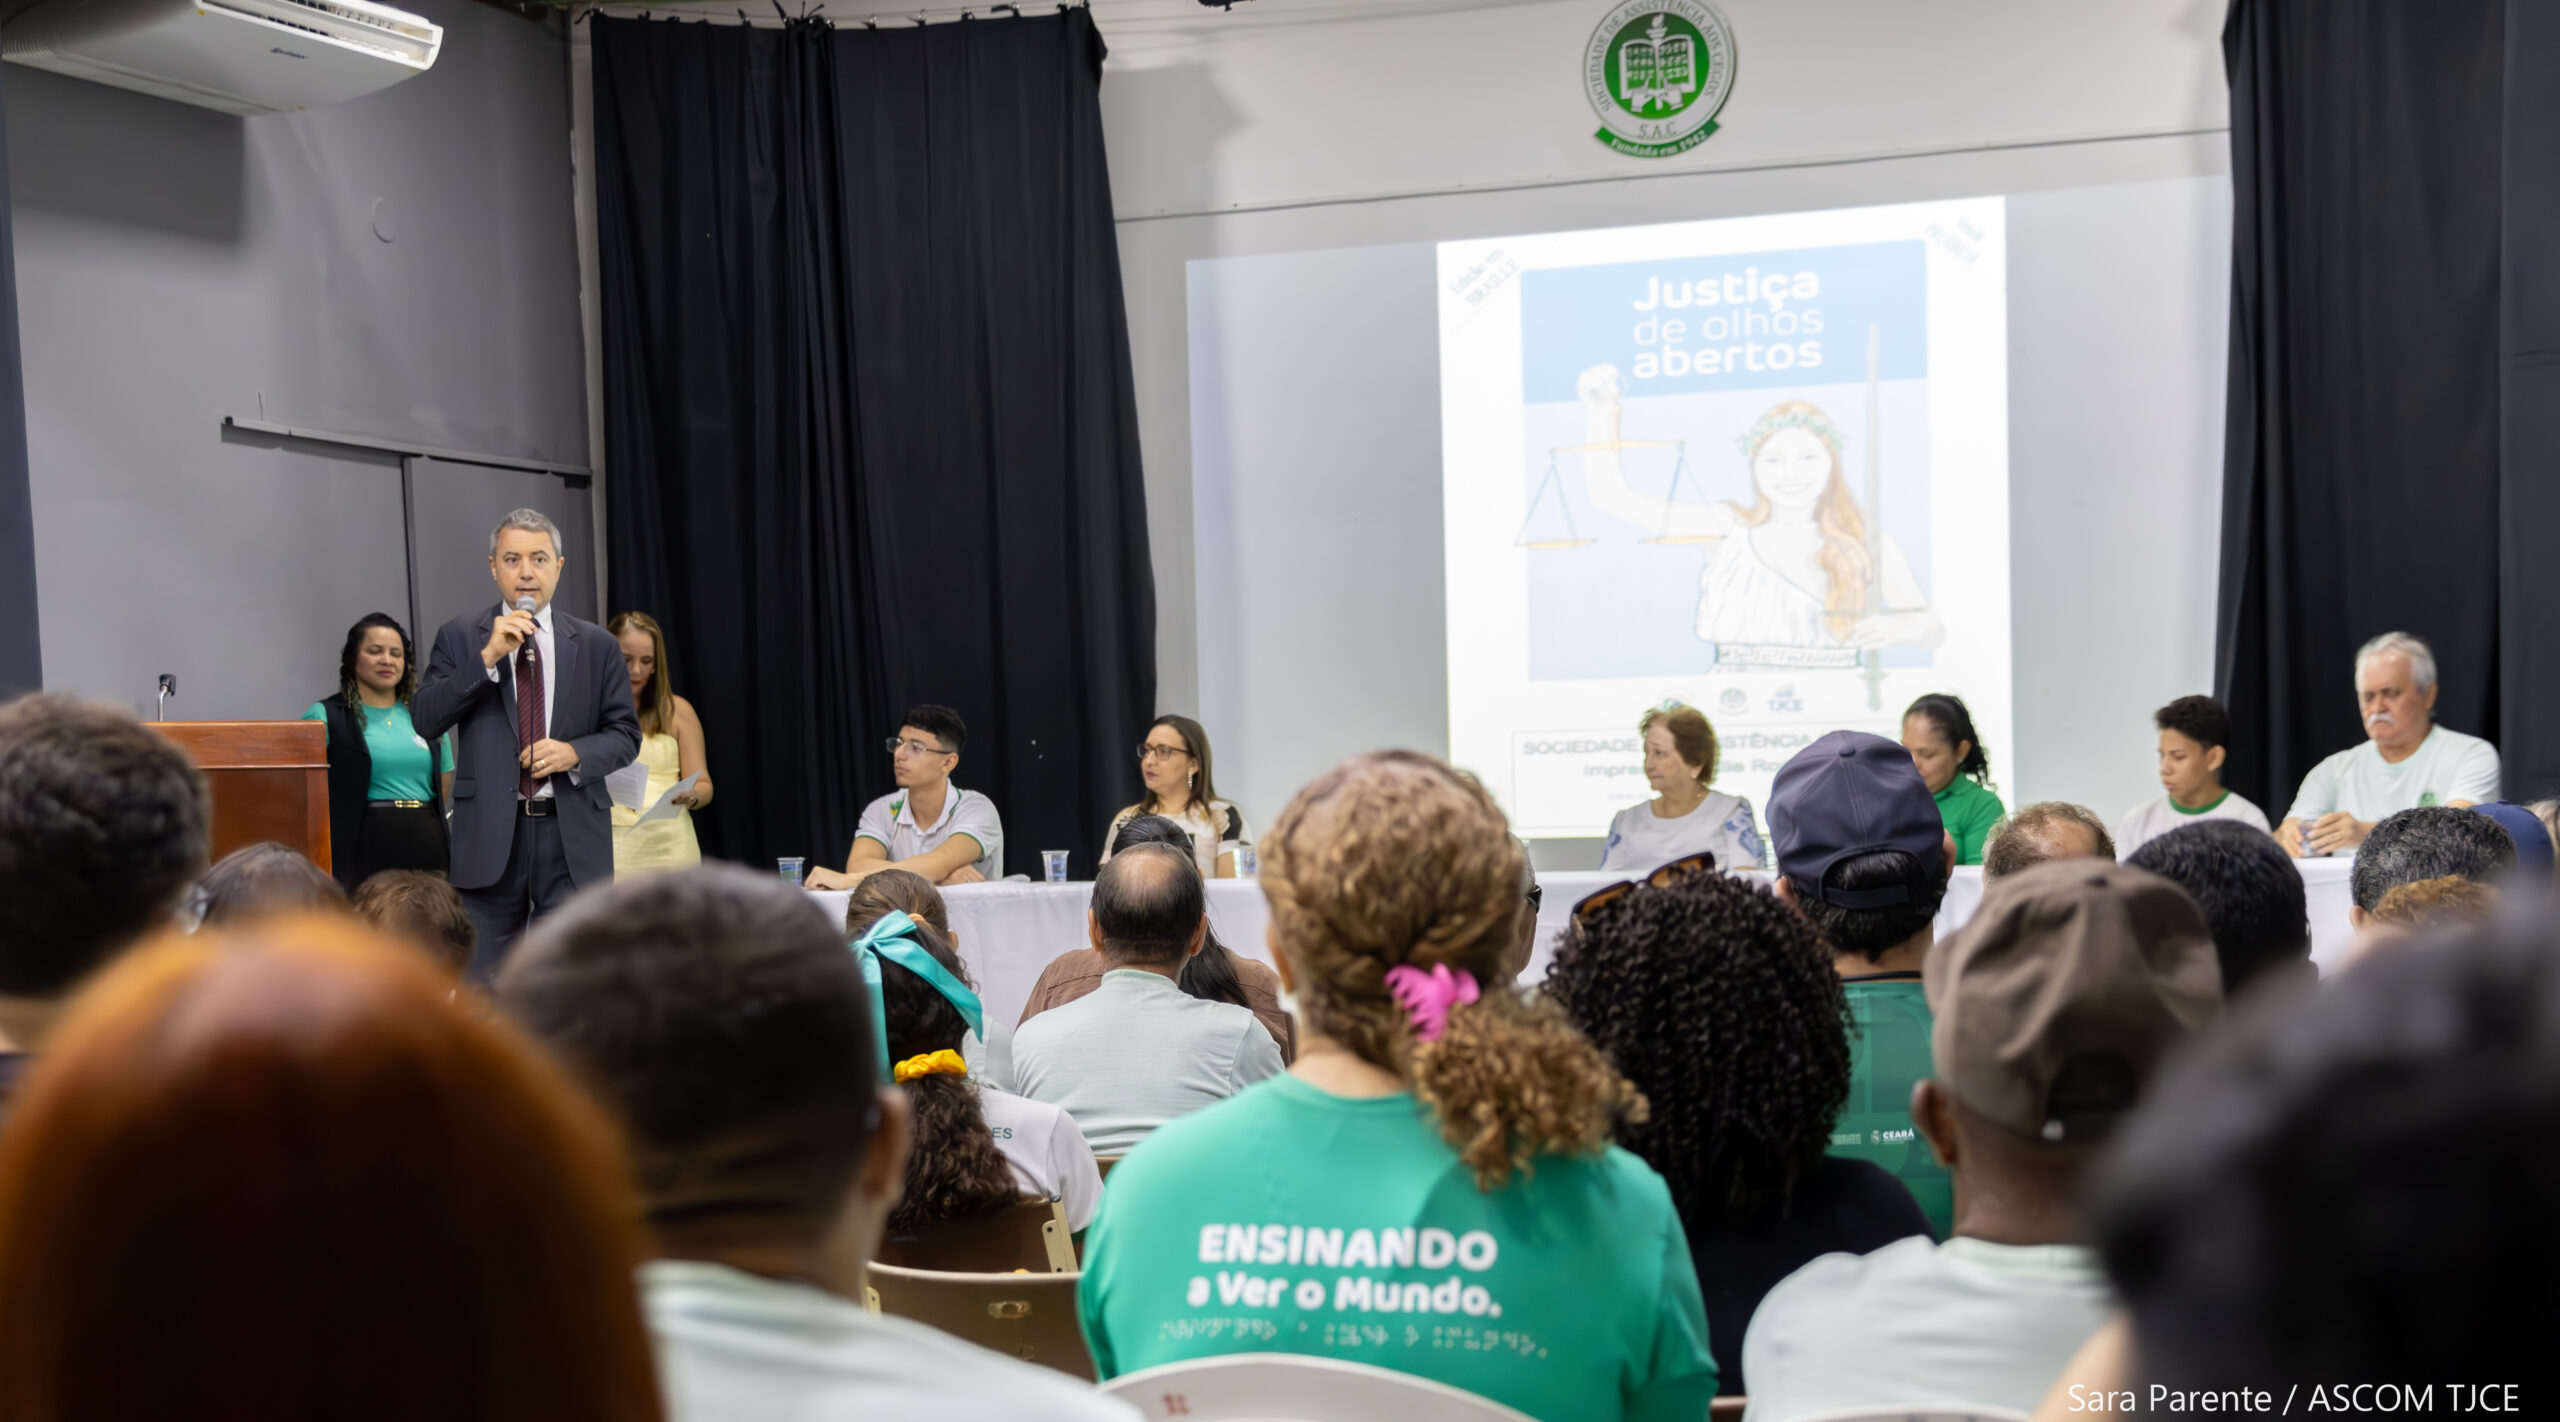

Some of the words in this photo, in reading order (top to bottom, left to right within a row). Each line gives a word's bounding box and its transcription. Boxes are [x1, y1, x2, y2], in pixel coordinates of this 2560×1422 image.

[1605, 15, 1624, 36] DE
[1632, 267, 1819, 313] Justiça
[1633, 314, 1687, 346] de
[1702, 306, 1823, 341] olhos
[1632, 340, 1822, 379] abertos
[1523, 738, 1640, 756] SOCIEDADE
[991, 1127, 1013, 1139] ES
[1883, 1128, 1914, 1139] CEARÁ
[1198, 1222, 1499, 1273] ENSINANDO
[1186, 1276, 1212, 1307] a
[1217, 1270, 1289, 1309] Ver
[1294, 1279, 1327, 1311] o
[1333, 1275, 1503, 1320] Mundo.
